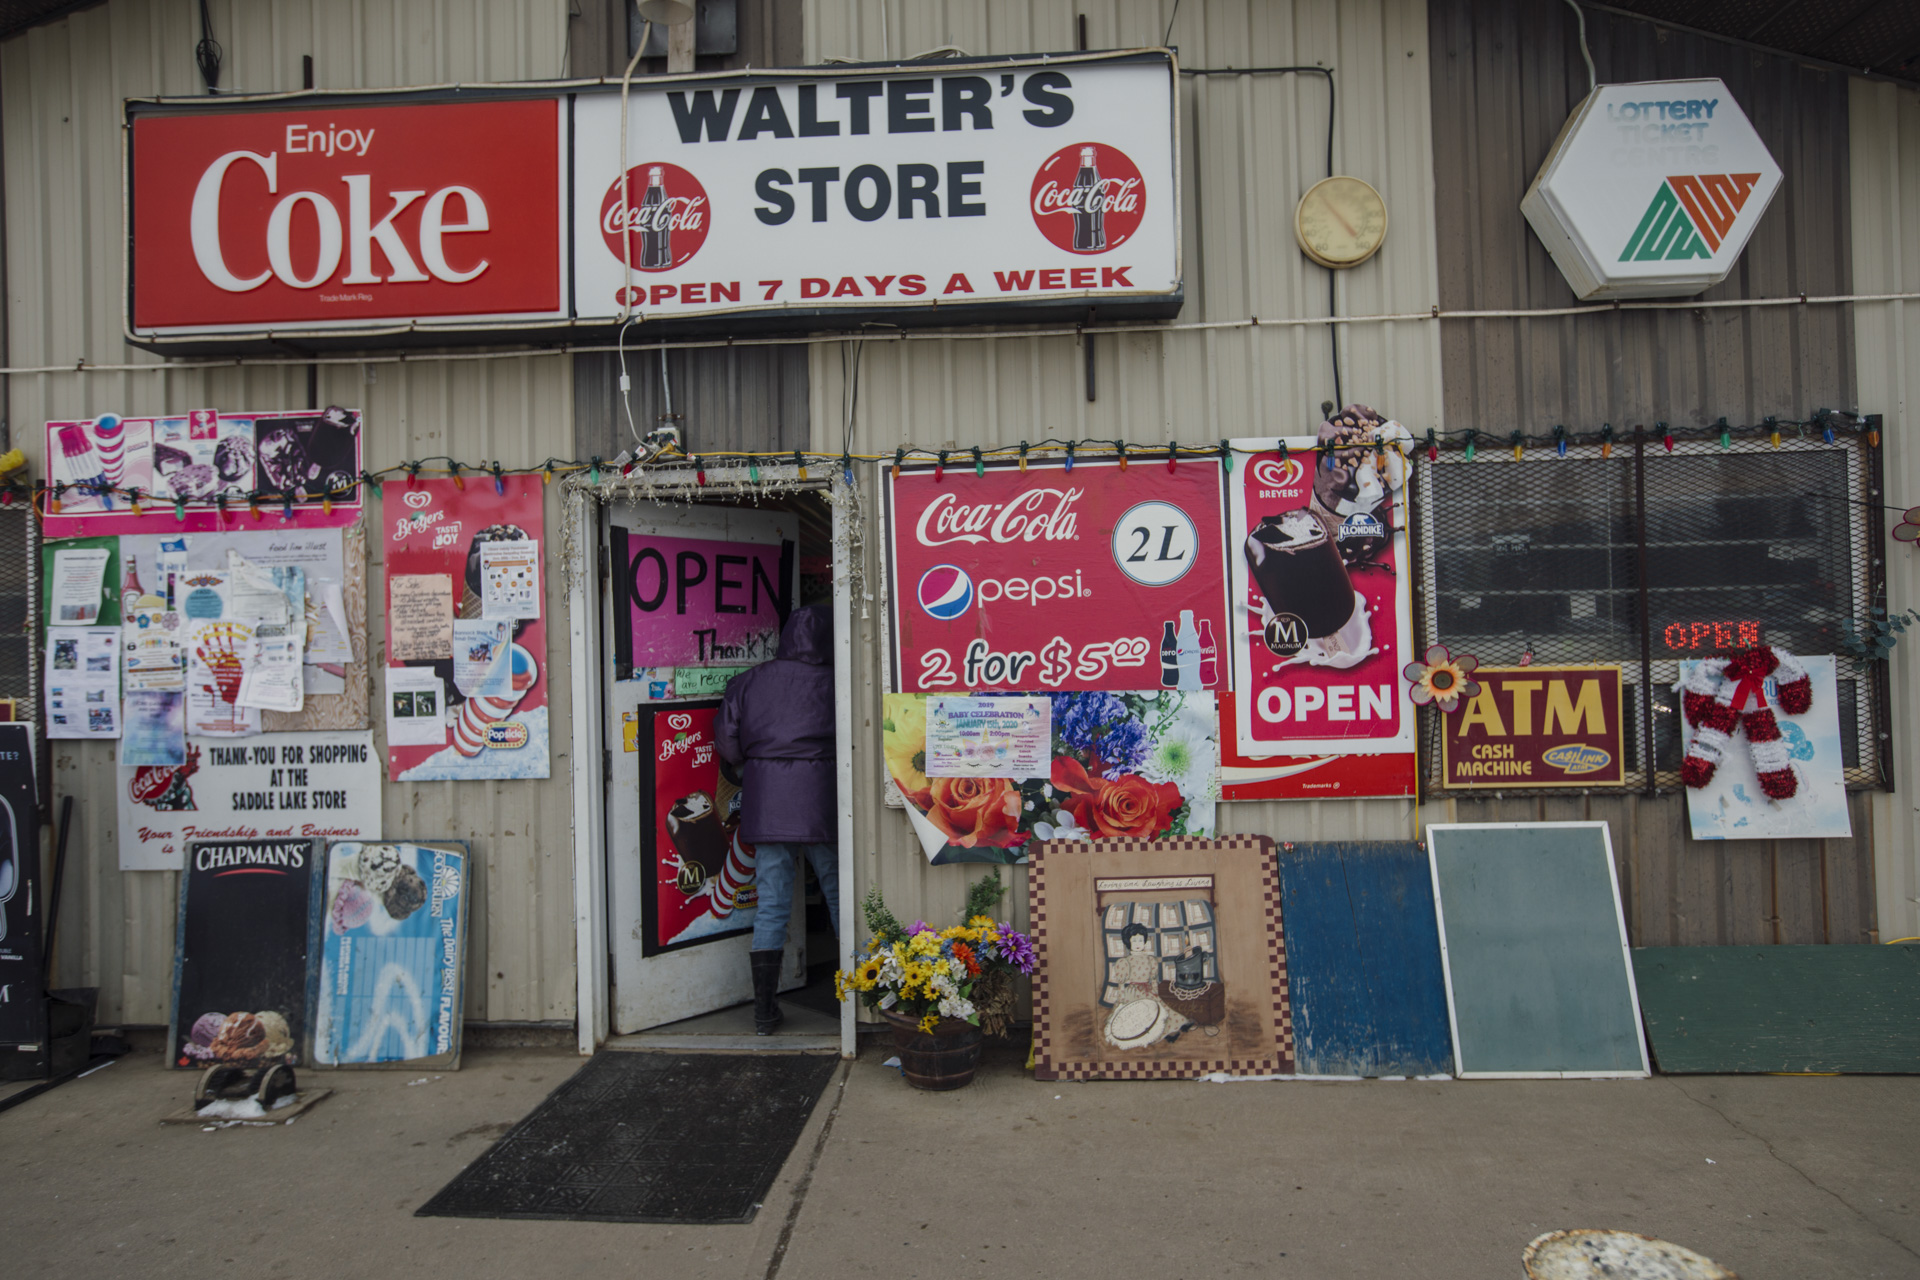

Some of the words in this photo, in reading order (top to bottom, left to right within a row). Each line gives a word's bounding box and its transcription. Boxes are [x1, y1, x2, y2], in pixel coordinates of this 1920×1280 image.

[666, 71, 1075, 145] WALTER'S
[1607, 99, 1719, 122] LOTTERY
[285, 123, 375, 157] Enjoy
[754, 161, 986, 226] STORE
[1034, 176, 1141, 219] Coca-Cola
[190, 150, 490, 293] Coke
[603, 194, 705, 235] Coca-Cola
[615, 281, 740, 307] OPEN
[758, 280, 784, 301] 7
[801, 274, 927, 298] DAYS
[943, 273, 975, 294] A
[993, 266, 1134, 292] WEEK
[1259, 489, 1299, 498] BREYERS
[435, 525, 458, 534] TASTE
[916, 487, 1084, 546] Coca-Cola
[1339, 524, 1384, 541] KLONDIKE
[630, 547, 780, 615] OPEN
[978, 569, 1082, 608] pepsi
[693, 629, 757, 662] Thank
[1665, 621, 1759, 649] OPEN
[676, 669, 691, 679] We
[918, 648, 957, 689] 2
[964, 638, 1035, 686] for
[970, 711, 1024, 719] CELEBRATION
[1257, 684, 1392, 723] OPEN
[1458, 679, 1607, 736] ATM
[955, 719, 986, 729] JANUARY
[1002, 721, 1018, 729] 2020
[210, 746, 276, 766] THANK-YOU
[282, 745, 304, 765] FOR
[309, 744, 368, 764] SHOPPING
[659, 731, 702, 761] Breyers
[694, 745, 712, 753] TASTE
[695, 753, 712, 764] JOY
[1472, 744, 1514, 759] CASH
[270, 769, 285, 787] AT
[287, 768, 309, 787] THE
[1457, 761, 1532, 776] MACHINE
[232, 791, 274, 811] SADDLE
[279, 791, 307, 810] LAKE
[312, 790, 347, 809] STORE
[137, 827, 174, 844] Your
[182, 825, 259, 841] Friendship
[266, 826, 294, 837] and
[301, 823, 361, 838] Business
[162, 843, 174, 854] is
[195, 844, 305, 871] CHAPMAN'S
[440, 917, 453, 937] The
[441, 938, 455, 966] Dairy
